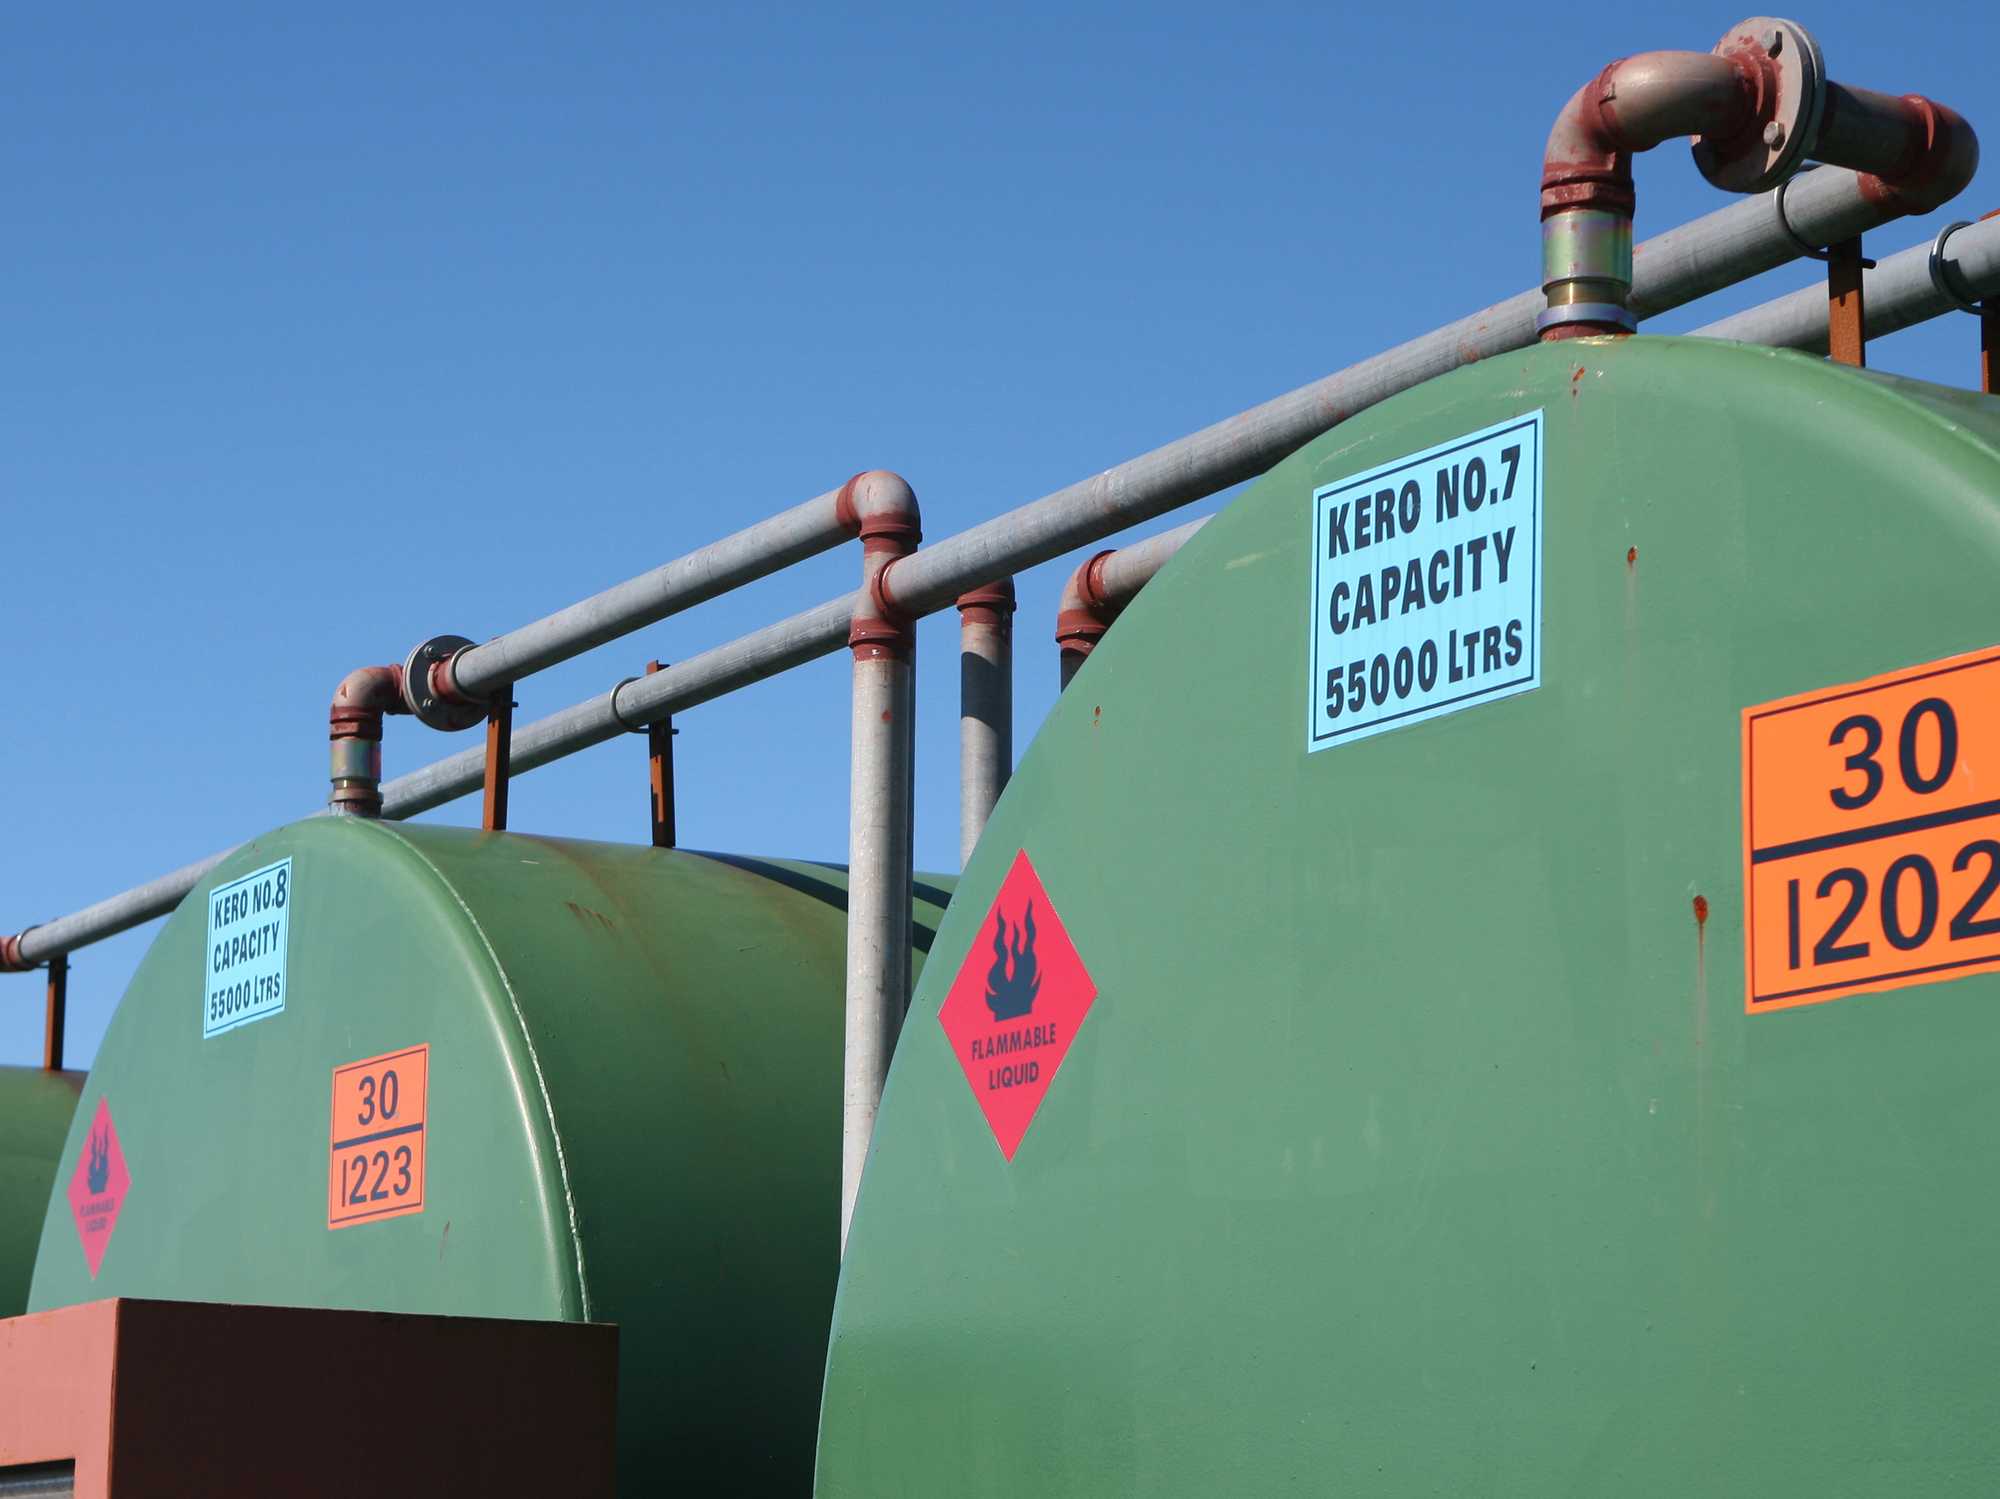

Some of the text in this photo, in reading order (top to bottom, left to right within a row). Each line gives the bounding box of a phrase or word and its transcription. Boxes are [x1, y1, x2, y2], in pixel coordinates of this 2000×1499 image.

[1328, 444, 1521, 560] KERO NO.7
[1329, 526, 1516, 635] CAPACITY
[1326, 619, 1522, 719] 55000 LTRS
[1828, 697, 1958, 811] 30
[214, 868, 287, 930] KERO NO.8
[213, 920, 280, 973] CAPACITY
[210, 972, 280, 1021] 55000 LTRS
[971, 1023, 1056, 1061] FLAMMABLE
[357, 1070, 398, 1126] 30
[988, 1062, 1039, 1090] LIQUID
[341, 1145, 412, 1207] 1223
